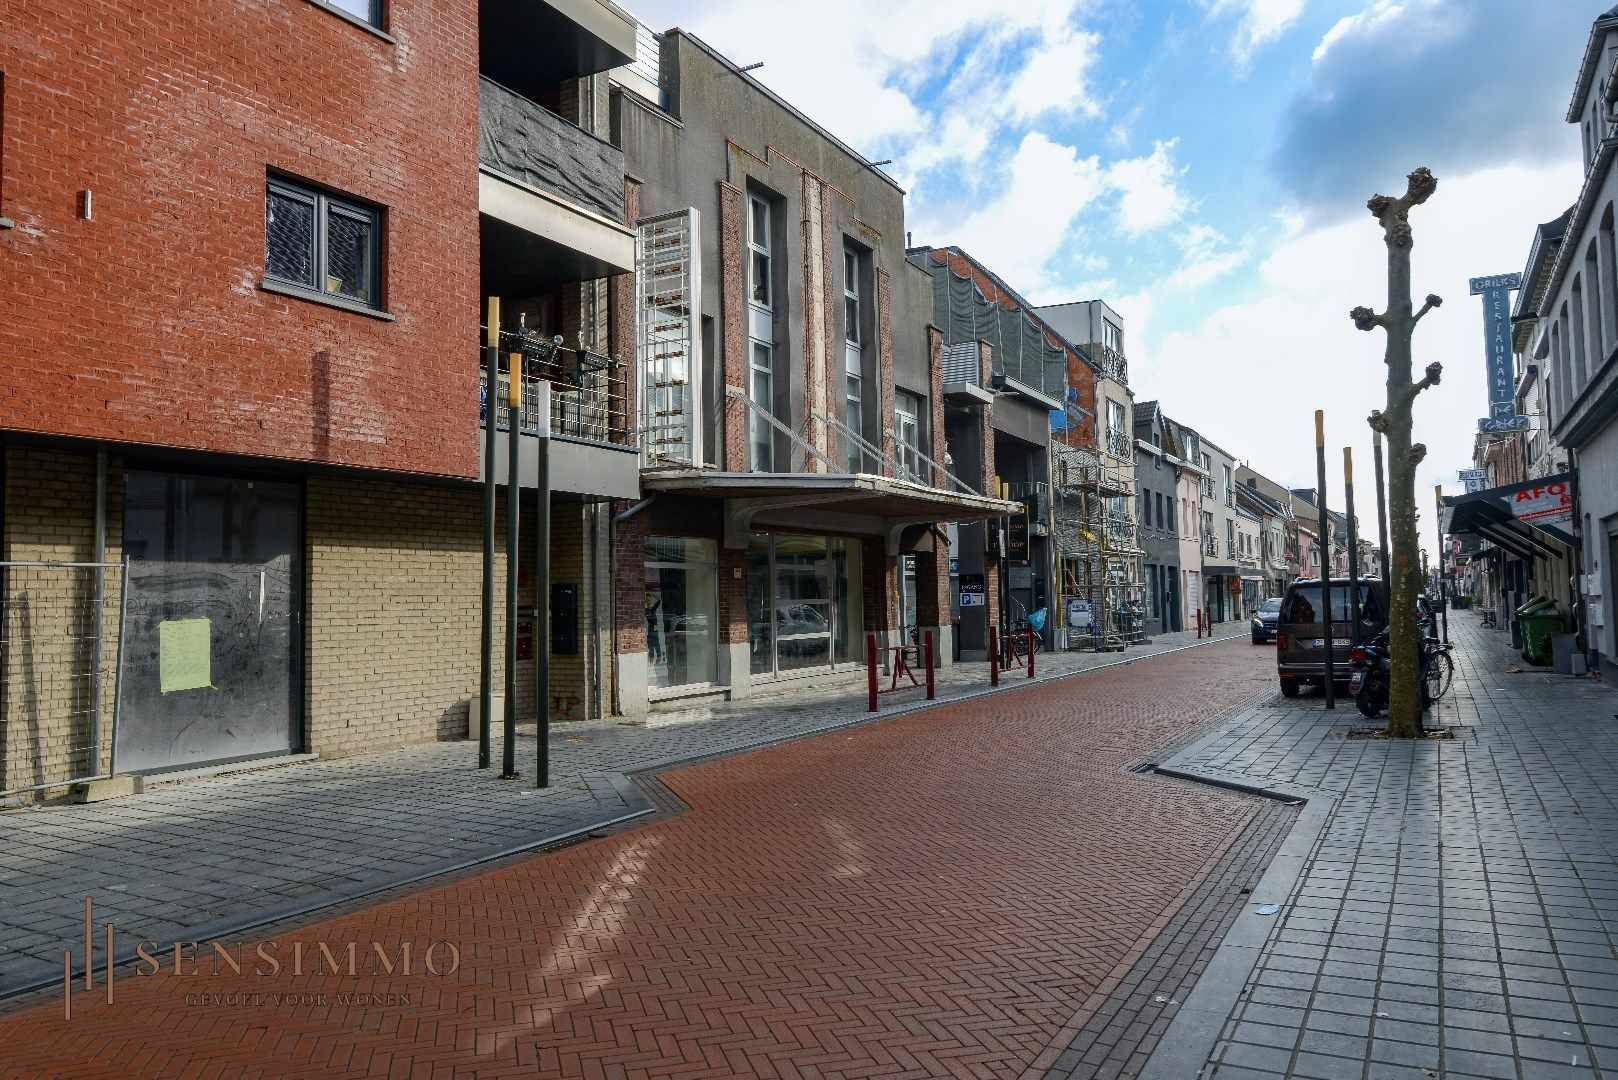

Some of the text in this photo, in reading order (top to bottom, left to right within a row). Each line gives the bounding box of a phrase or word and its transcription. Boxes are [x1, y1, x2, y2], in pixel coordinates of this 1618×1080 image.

[1475, 277, 1516, 289] GRIEKS
[1492, 290, 1506, 398] RESTAURANT
[963, 595, 970, 603] P
